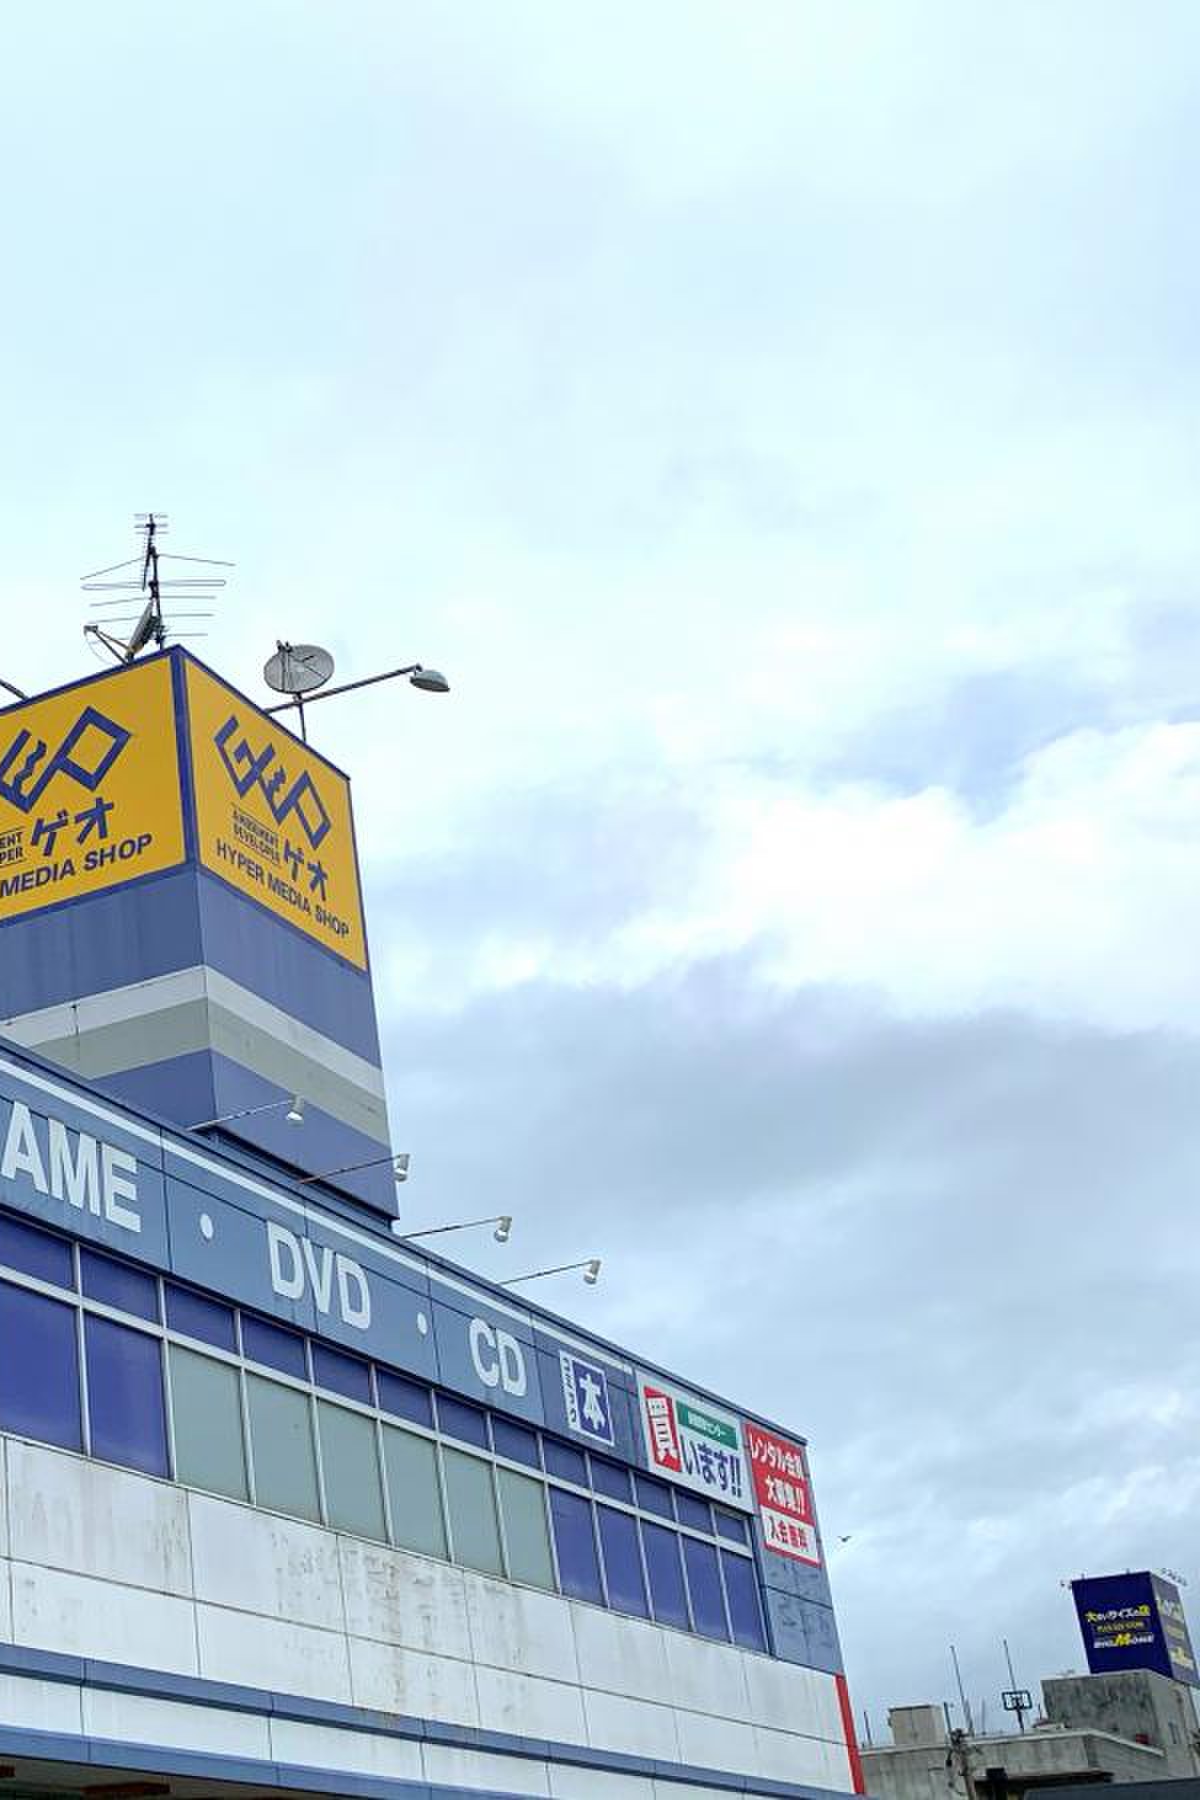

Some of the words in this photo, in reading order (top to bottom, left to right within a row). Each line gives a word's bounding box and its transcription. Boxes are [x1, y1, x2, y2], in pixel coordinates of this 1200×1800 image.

[31, 797, 114, 857] ゲオ
[0, 859, 76, 898] MEDIA
[83, 833, 153, 872] SHOP
[216, 838, 266, 886] HYPER
[268, 874, 312, 916] MEDIA
[315, 904, 350, 938] SHOP
[283, 838, 329, 901] ゲオ
[266, 1219, 371, 1329] DVD
[469, 1318, 527, 1397] CD
[579, 1373, 606, 1430] 本
